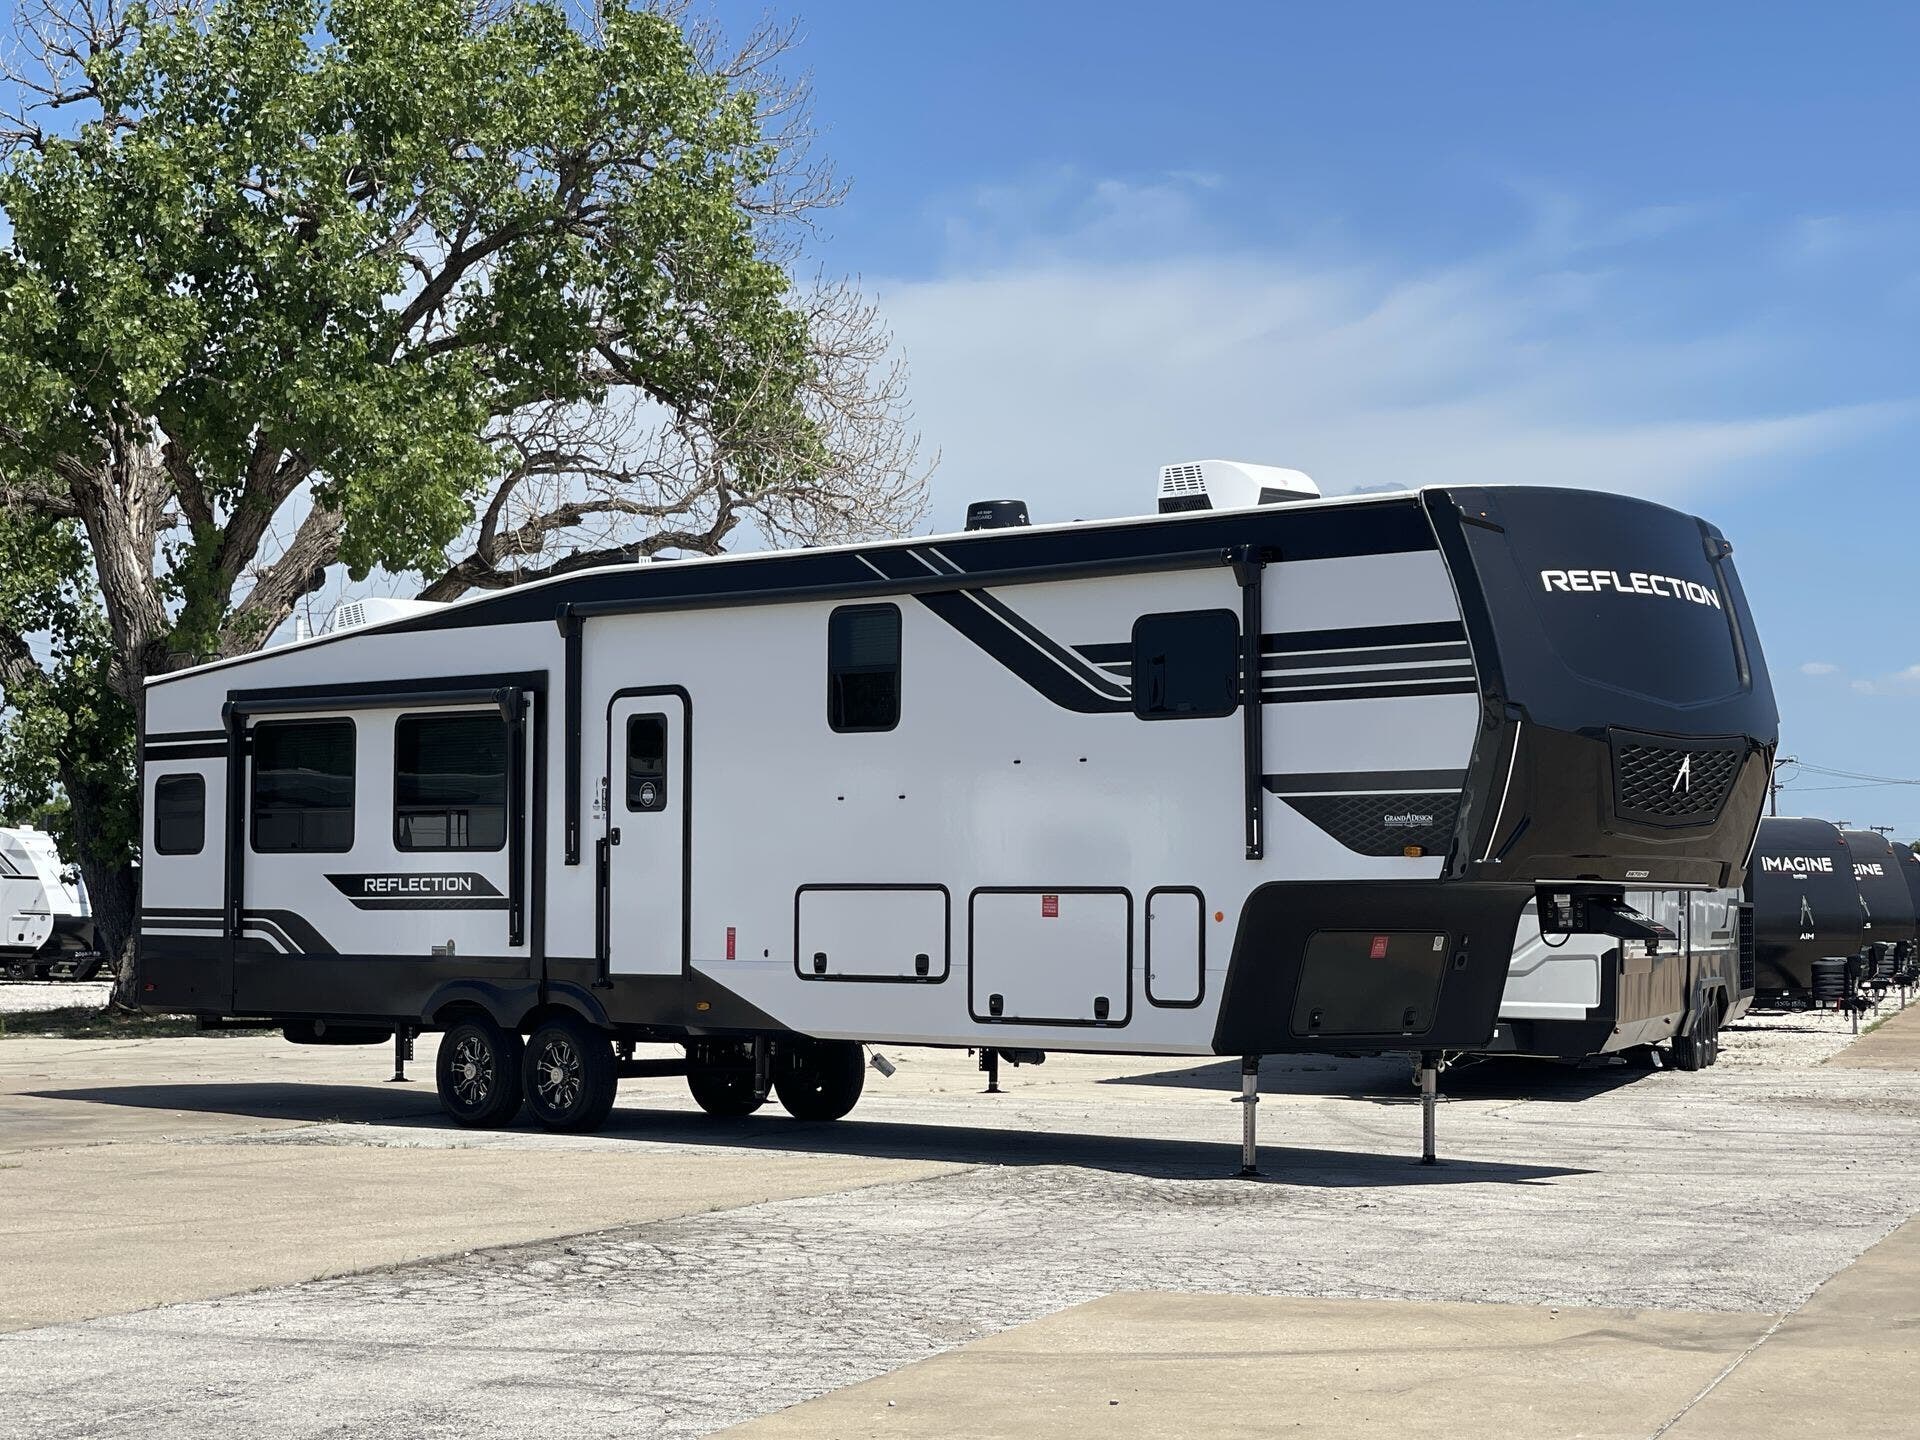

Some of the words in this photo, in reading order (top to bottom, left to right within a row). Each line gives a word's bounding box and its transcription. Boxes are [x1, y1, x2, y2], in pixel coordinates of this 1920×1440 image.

[1541, 570, 1721, 610] REFLECTION
[1761, 856, 1834, 872] IMAGINE
[364, 877, 472, 892] REFLECTION
[1800, 932, 1815, 940] AIM
